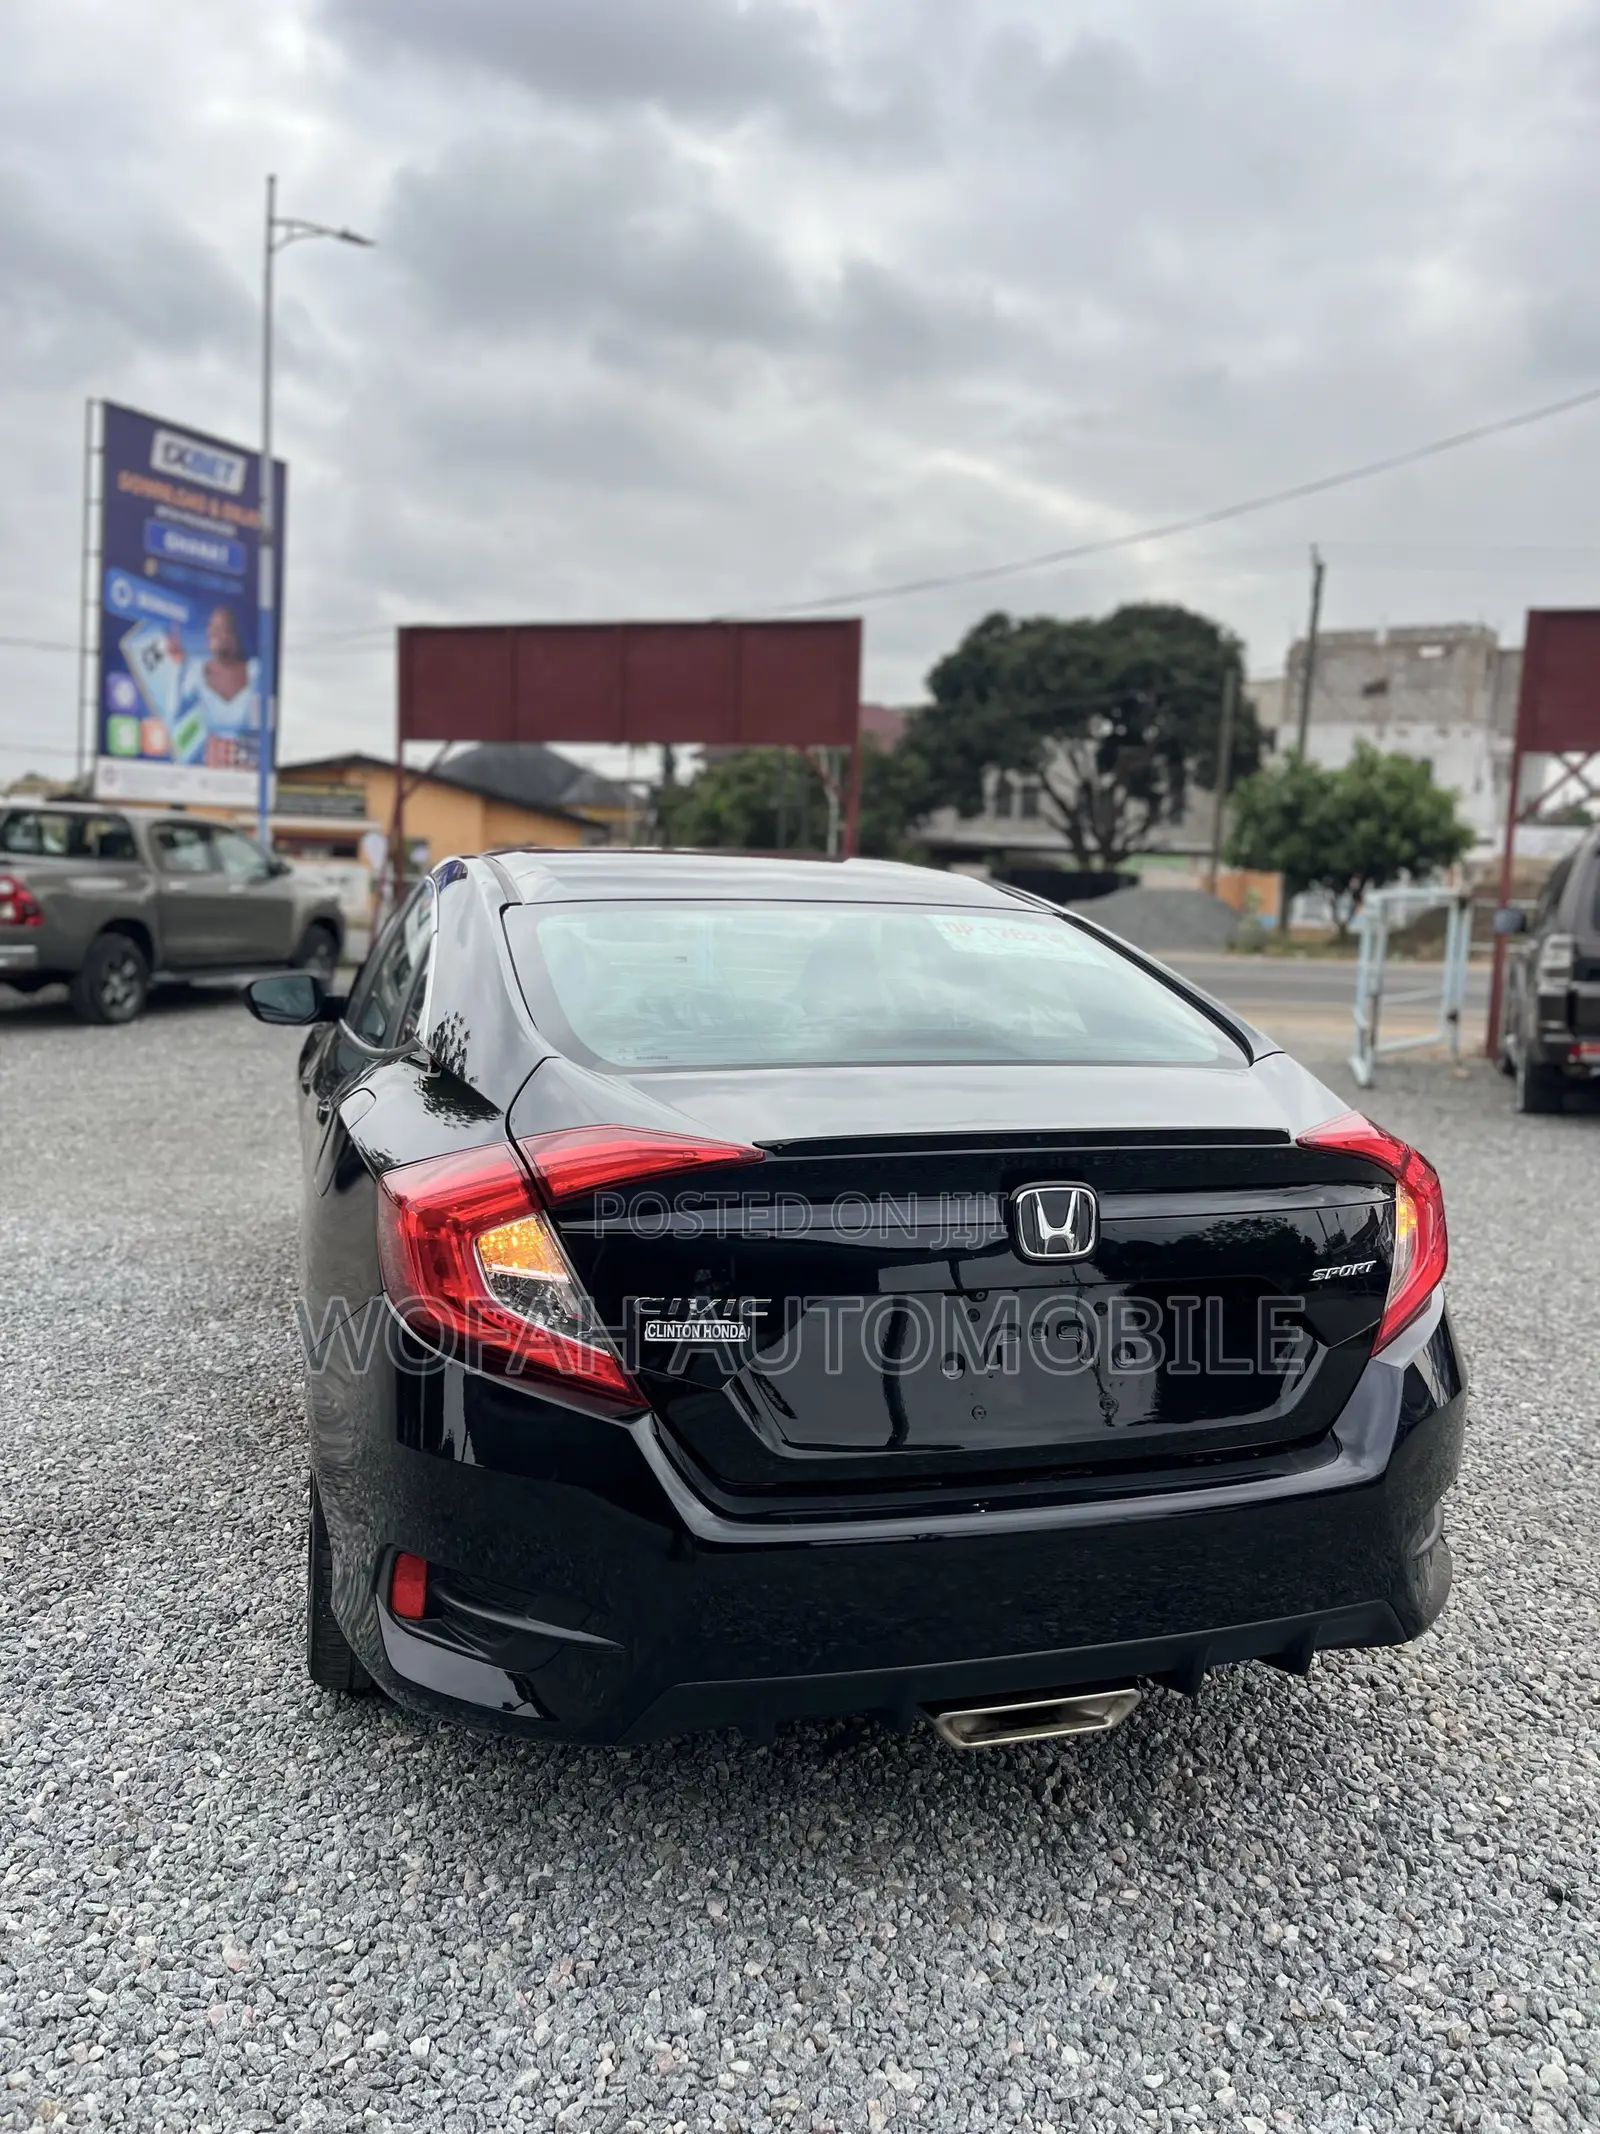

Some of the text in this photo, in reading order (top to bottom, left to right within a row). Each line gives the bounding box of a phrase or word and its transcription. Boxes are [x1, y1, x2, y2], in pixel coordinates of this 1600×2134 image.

[1308, 1260, 1377, 1282] SPORT
[633, 1297, 772, 1316] CIVIC
[647, 1324, 747, 1338] CLINTON HONDA
